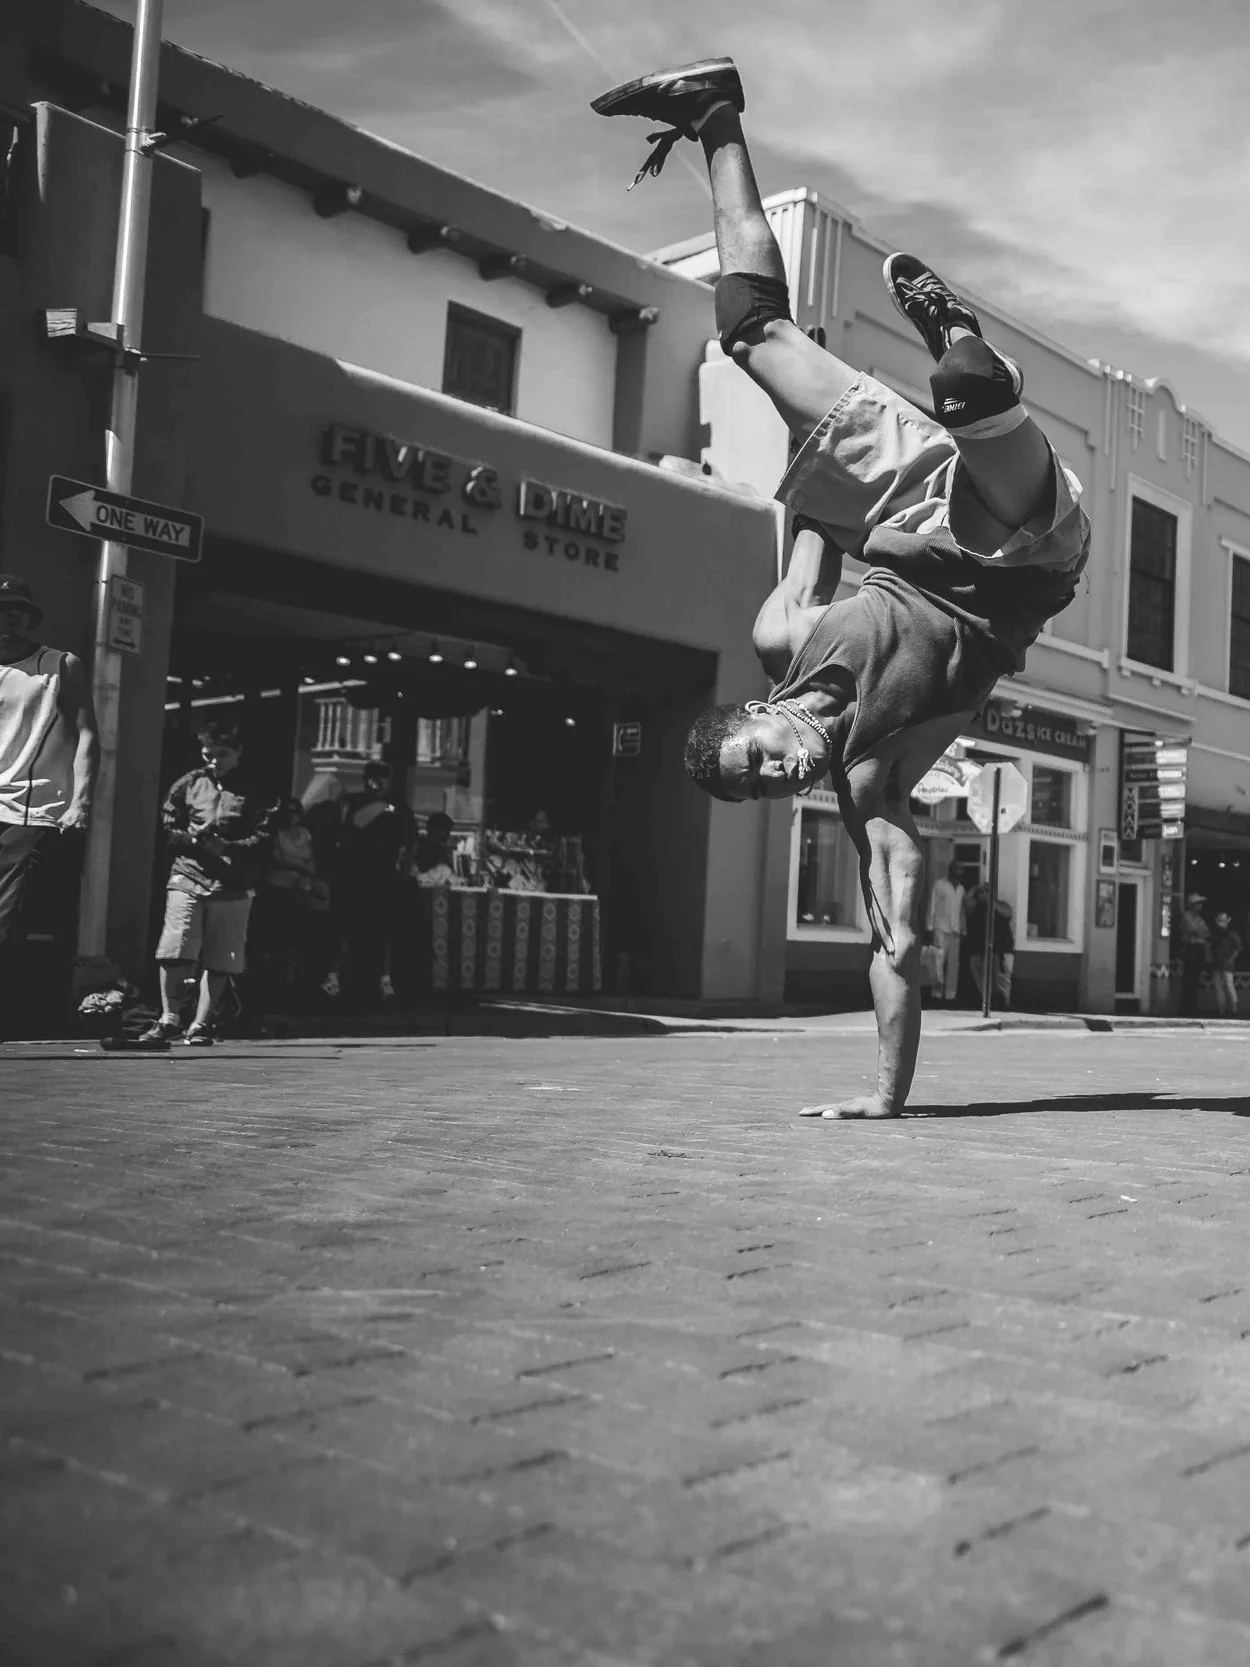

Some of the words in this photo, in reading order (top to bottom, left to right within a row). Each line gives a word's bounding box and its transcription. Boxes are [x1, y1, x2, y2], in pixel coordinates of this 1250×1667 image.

[323, 425, 451, 493] FIVE
[463, 466, 501, 508] &
[519, 480, 627, 542] DIME
[96, 504, 136, 532] ONE
[144, 516, 185, 542] WAY
[311, 474, 477, 534] GENERAL
[522, 530, 619, 572] STORE
[1036, 724, 1051, 740] ICE
[1054, 730, 1087, 748] CREAM
